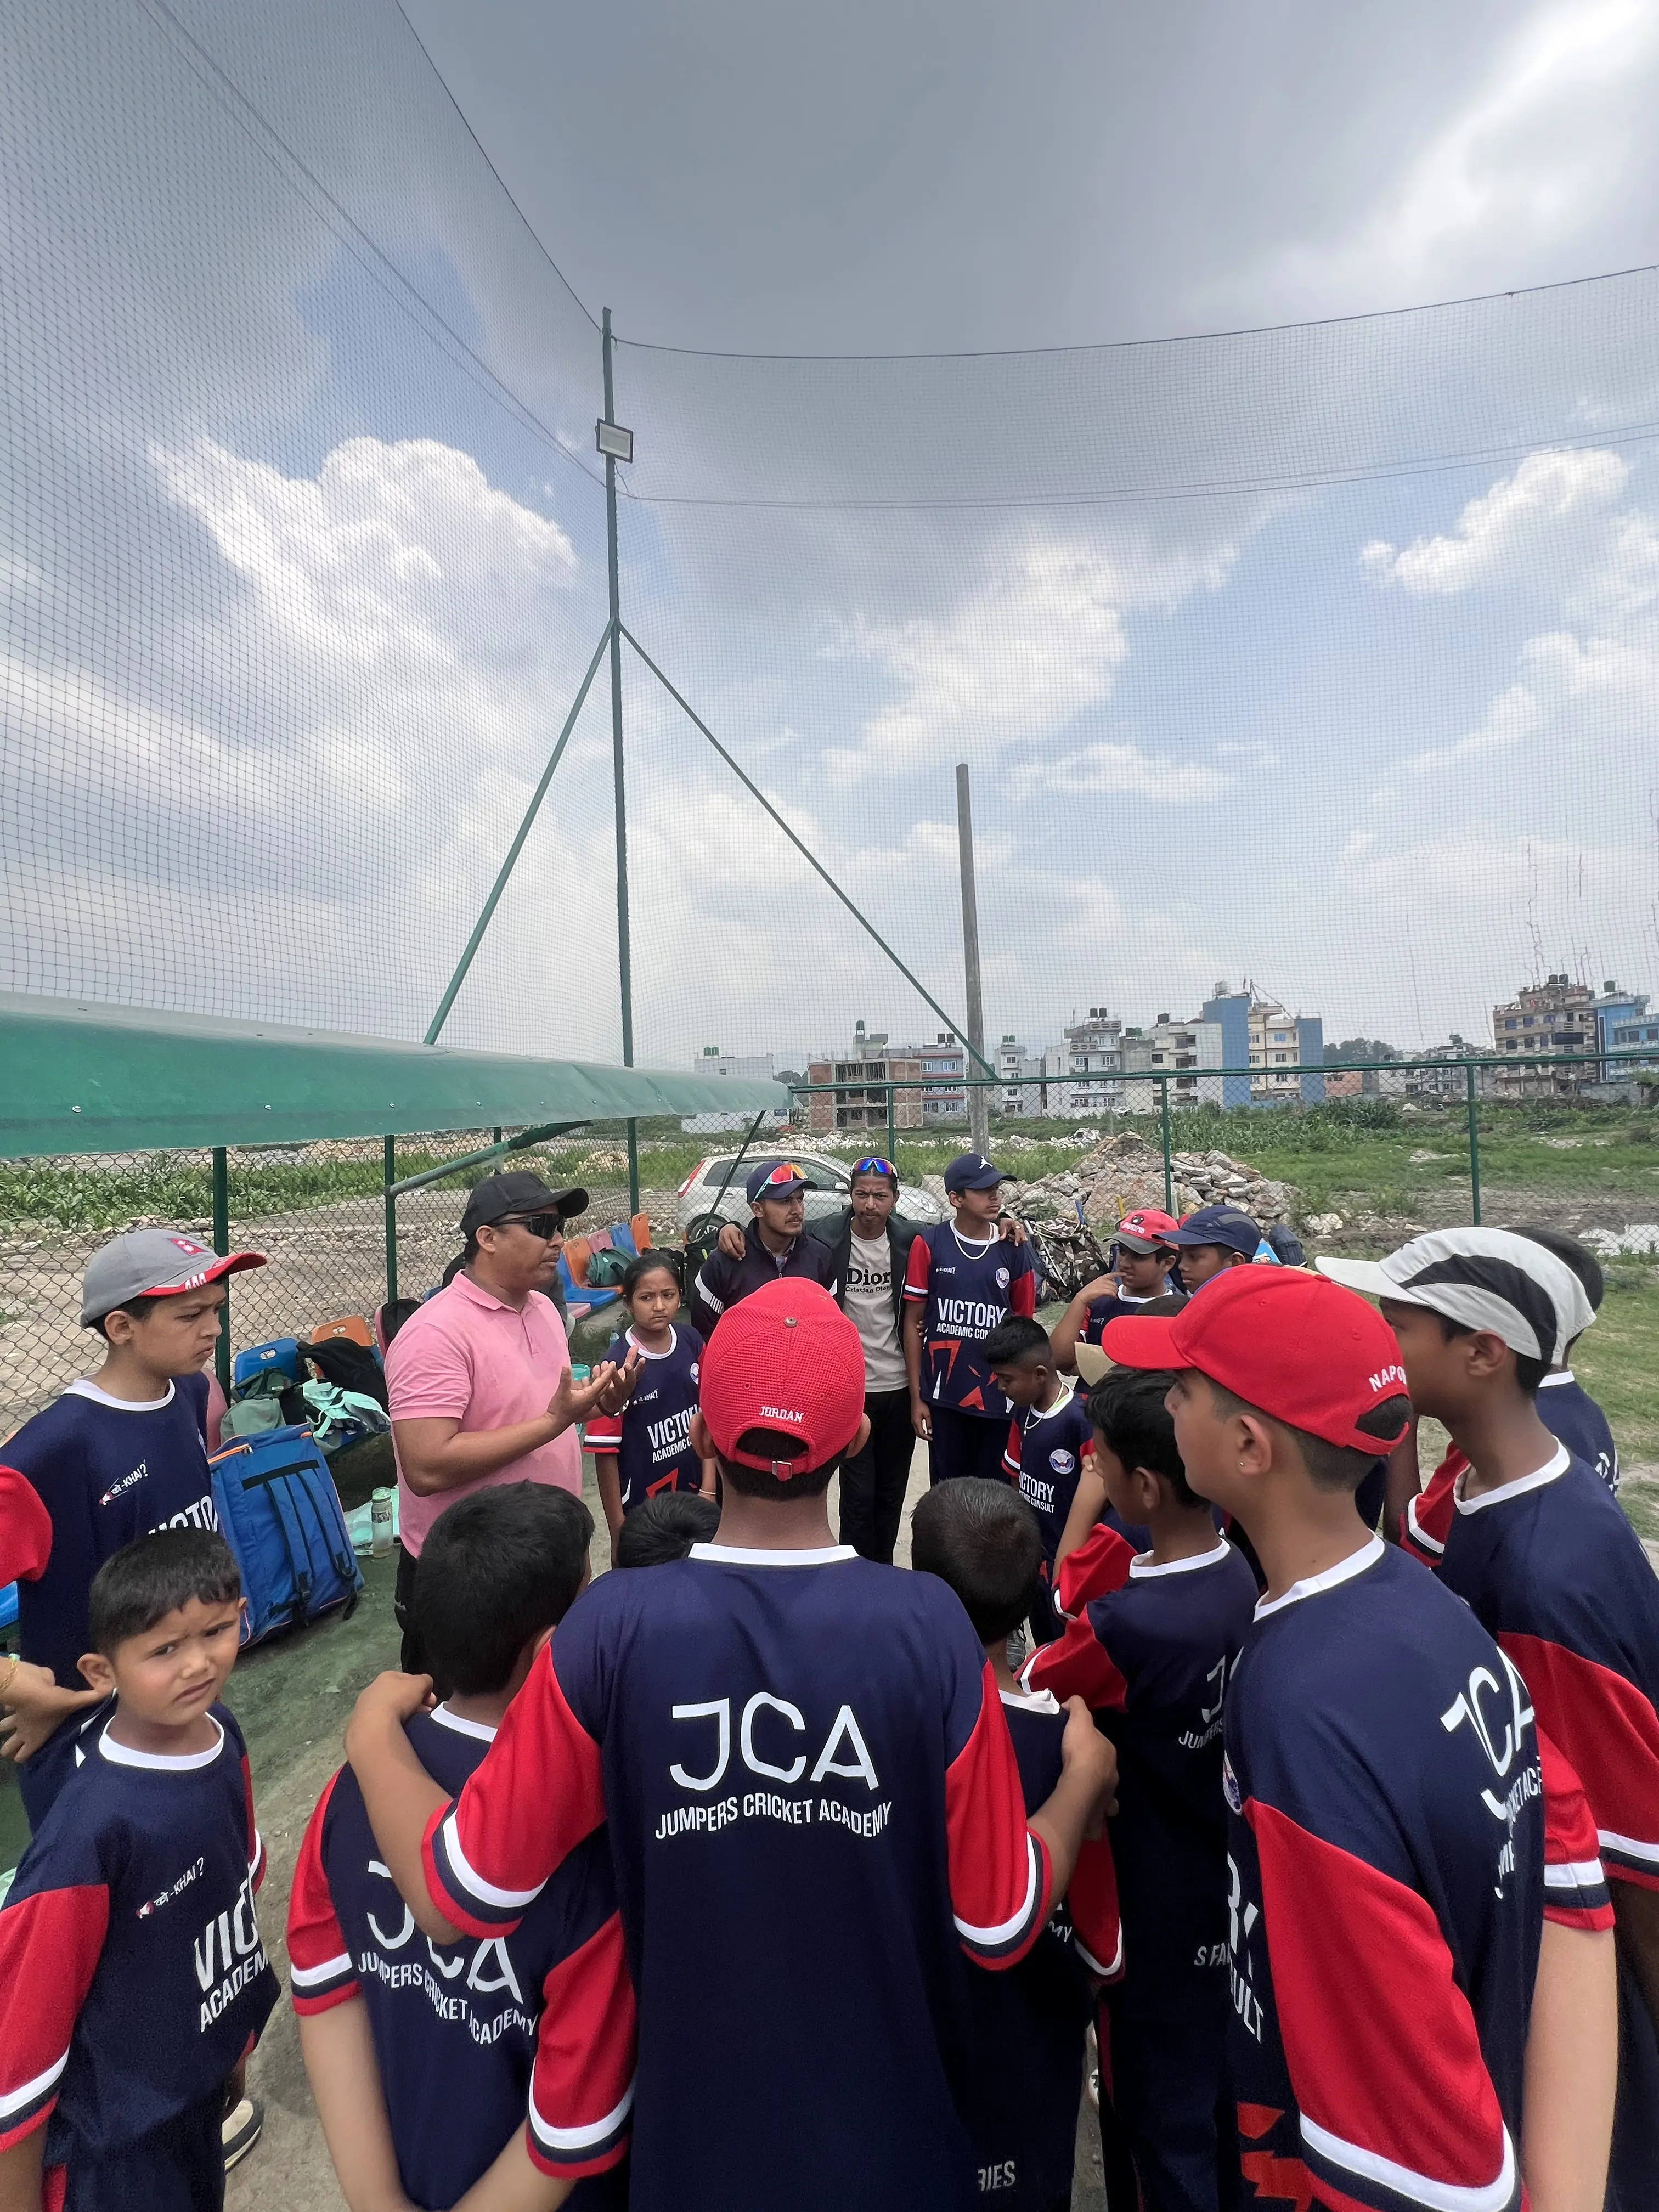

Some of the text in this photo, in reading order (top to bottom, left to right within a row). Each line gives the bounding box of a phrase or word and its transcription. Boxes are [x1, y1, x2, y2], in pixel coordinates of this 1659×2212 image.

[846, 1268, 891, 1286] Dior
[937, 1297, 1007, 1328] VICTORY
[936, 1322, 973, 1338] ACADEMIC
[759, 1406, 804, 1423] JORDAN
[652, 1438, 687, 1463] ACADEMIC
[1019, 1470, 1054, 1503] ICTORY
[1030, 1497, 1055, 1514] CONSULT
[669, 1691, 879, 1791] JCA
[655, 1792, 893, 1839] JUMPERS CRICKET ACADEMY
